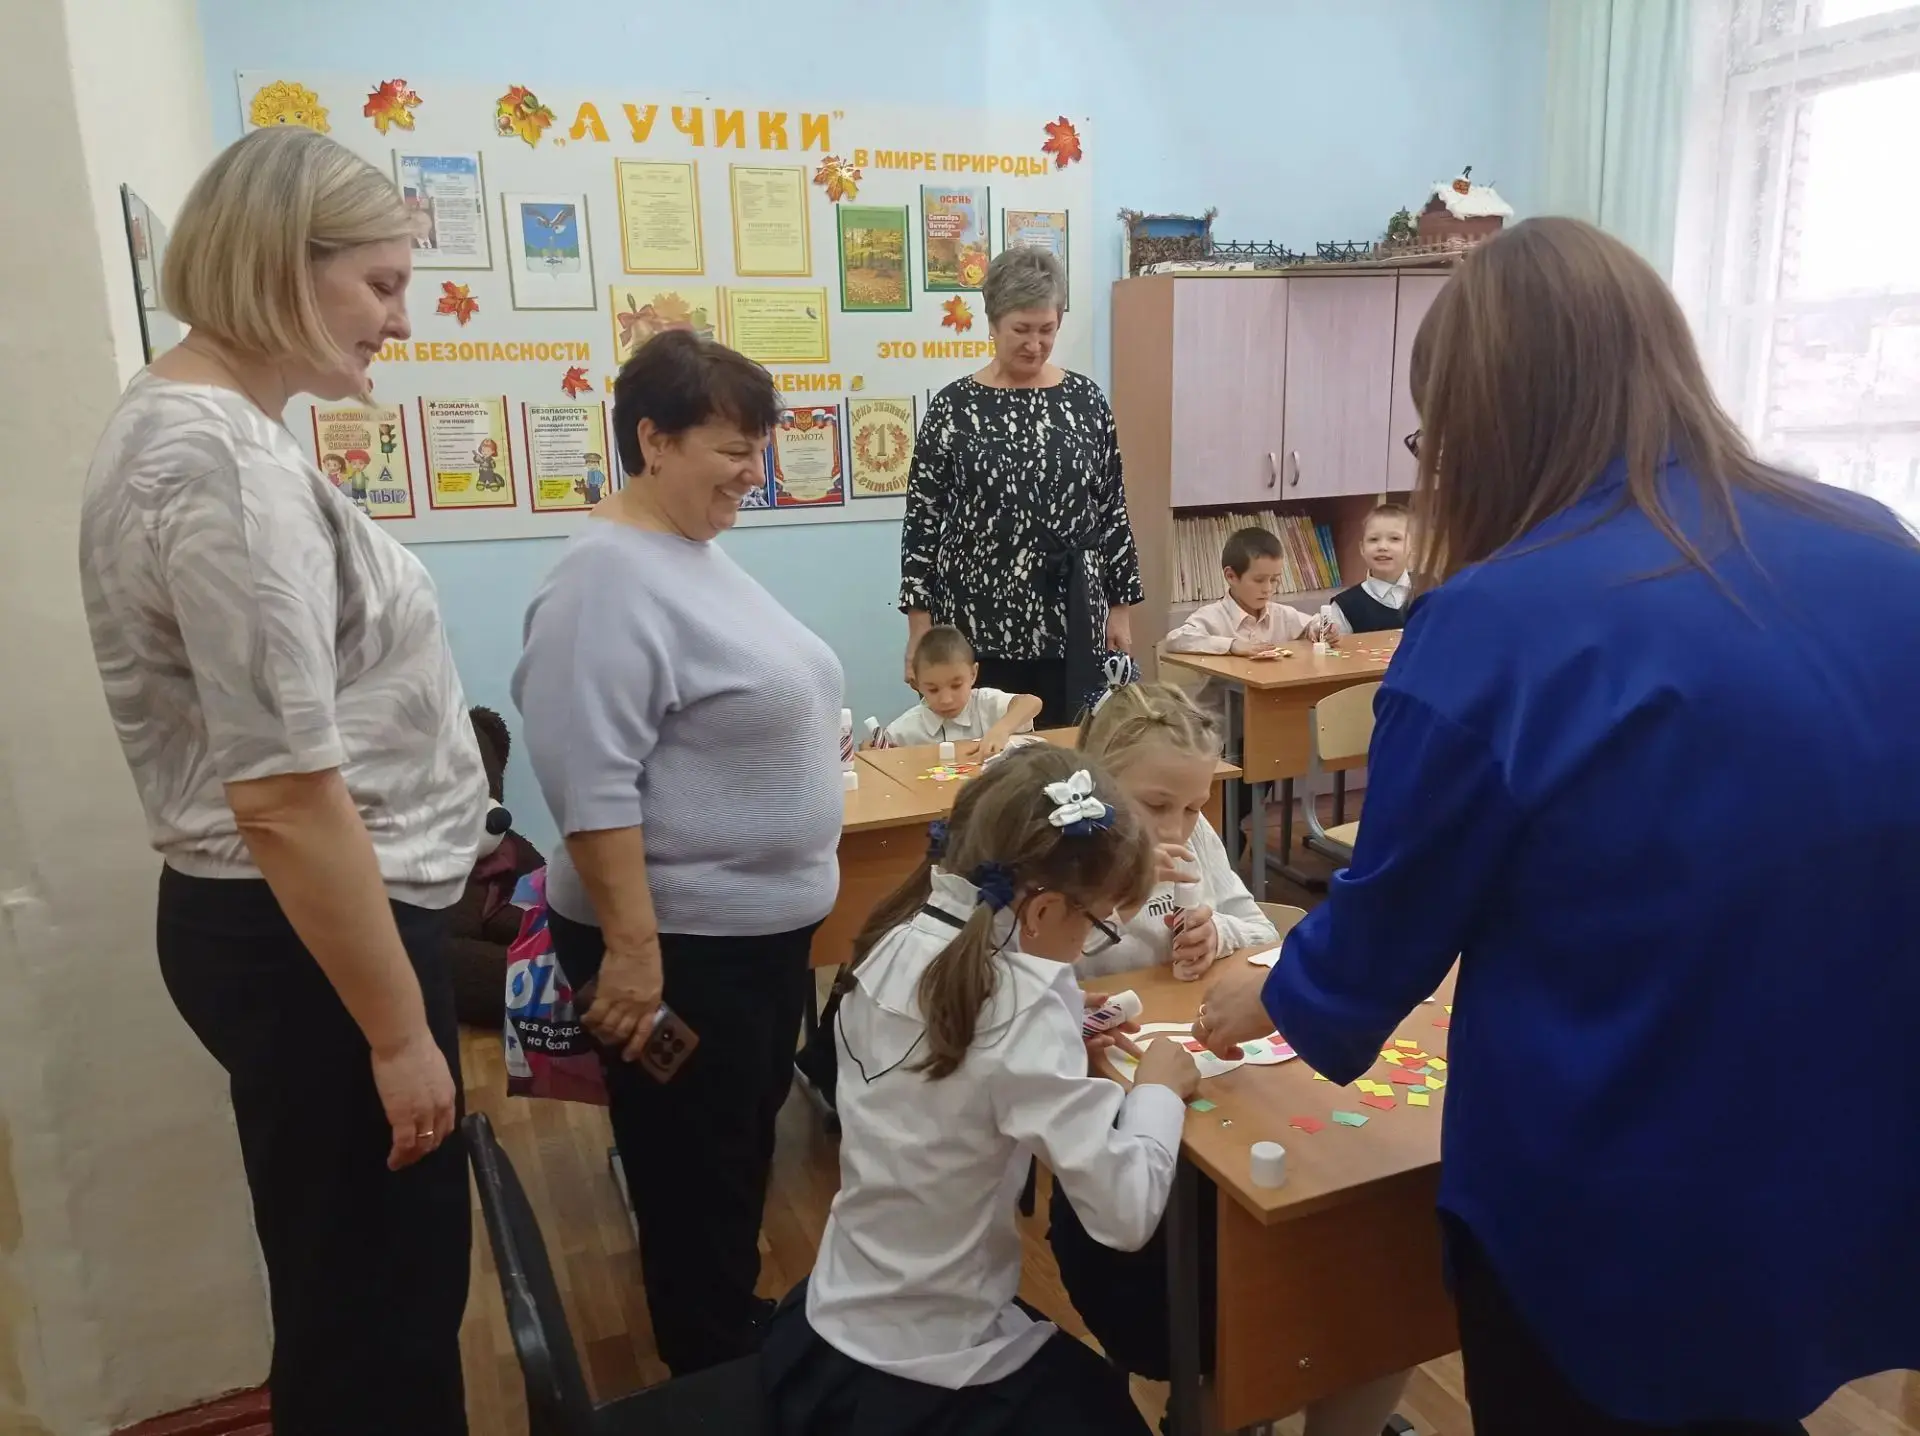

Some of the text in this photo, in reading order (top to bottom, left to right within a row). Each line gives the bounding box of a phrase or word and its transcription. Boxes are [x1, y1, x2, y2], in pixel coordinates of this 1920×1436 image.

[853, 149, 1049, 177] В МИРЕ ПРИРОДЫ
[940, 195, 972, 204] ОСЕНЬ
[414, 341, 591, 362] БЕЗОПАСНОСТИ
[877, 341, 918, 359] ЭТО
[437, 402, 480, 410] ПОЖАРНАЯ
[552, 414, 580, 422] ДОРОГЕ
[785, 433, 825, 443] ГРАМОТА
[874, 423, 888, 457] 1
[377, 466, 394, 482] А
[369, 487, 408, 505] ТЫ?
[519, 1021, 539, 1032] вся
[527, 1036, 542, 1046] на
